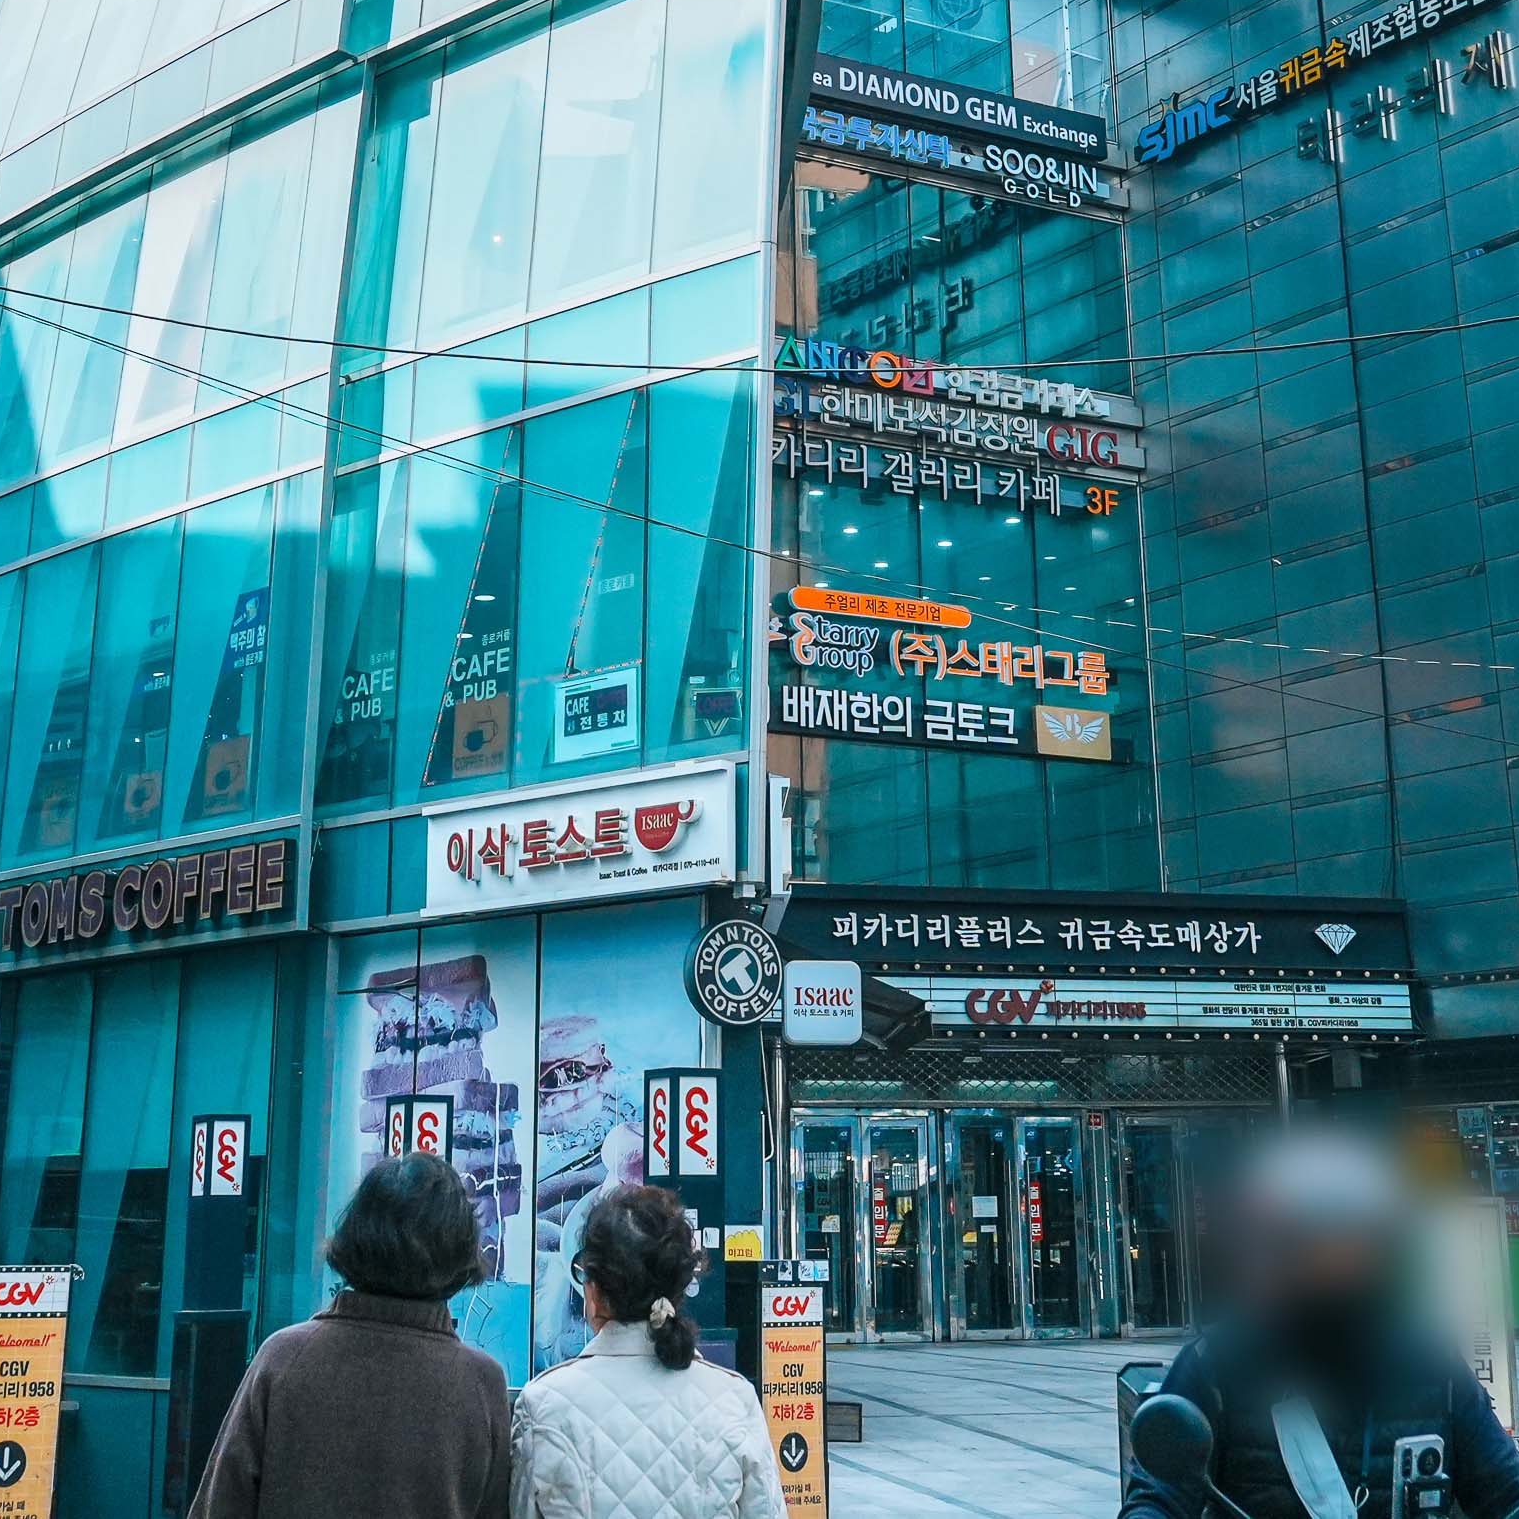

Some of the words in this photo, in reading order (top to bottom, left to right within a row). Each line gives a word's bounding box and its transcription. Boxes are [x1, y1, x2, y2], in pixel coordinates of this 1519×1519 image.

[839, 67, 959, 114] DIAMOND
[966, 97, 1017, 130] GEM
[1024, 116, 1097, 150] Exchange
[985, 145, 1097, 194] SOO&JIN
[1004, 178, 1081, 208] GOLD
[819, 384, 1039, 456] 한미보석감정원
[1045, 424, 1118, 467] GIG
[883, 451, 982, 505] 갤러리
[998, 469, 1061, 516] 카페
[1086, 487, 1119, 515] 3F
[824, 593, 860, 614] 주얼리
[865, 599, 888, 615] 제조
[894, 602, 941, 622] 전문기업
[790, 613, 879, 651] Starry
[451, 649, 509, 681] CAFE
[792, 642, 874, 677] Group
[890, 629, 1110, 696] (주)스태리그룹
[342, 667, 394, 699] CAFE
[463, 680, 497, 704] PUB
[351, 697, 381, 719] PUB
[566, 697, 589, 715] CAFE
[580, 710, 626, 730] 전통차
[782, 686, 913, 737] 배재한의
[924, 699, 1019, 744] 금토크
[642, 813, 674, 830] Isaac
[447, 823, 511, 881] 이삭
[519, 808, 626, 868] 토스트
[113, 840, 286, 930] COFFEE
[599, 871, 611, 880] Isaac
[832, 912, 1044, 948] 피카디리플러스
[1058, 917, 1261, 956] 귀금속도매상가
[700, 933, 725, 974] TOM
[726, 926, 738, 941] N
[741, 927, 777, 976] TOMS
[705, 984, 773, 1018] COFFEE
[794, 987, 853, 1006] Isaac
[966, 989, 1041, 1024] CGV
[794, 1009, 807, 1017] 이삭
[810, 1009, 829, 1017] 토스트
[685, 1086, 709, 1157] CGV
[217, 1128, 238, 1183] CGV
[728, 1248, 753, 1257] 미끄럼
[772, 1296, 810, 1317] CGV
[0, 1361, 28, 1377] CGV
[783, 1364, 804, 1377] CGV
[763, 1382, 822, 1395] 피카디리1958
[15, 1406, 40, 1426] 2층
[772, 1405, 794, 1421] 지하
[797, 1405, 814, 1420] 2층
[804, 1495, 821, 1505] 주세요
